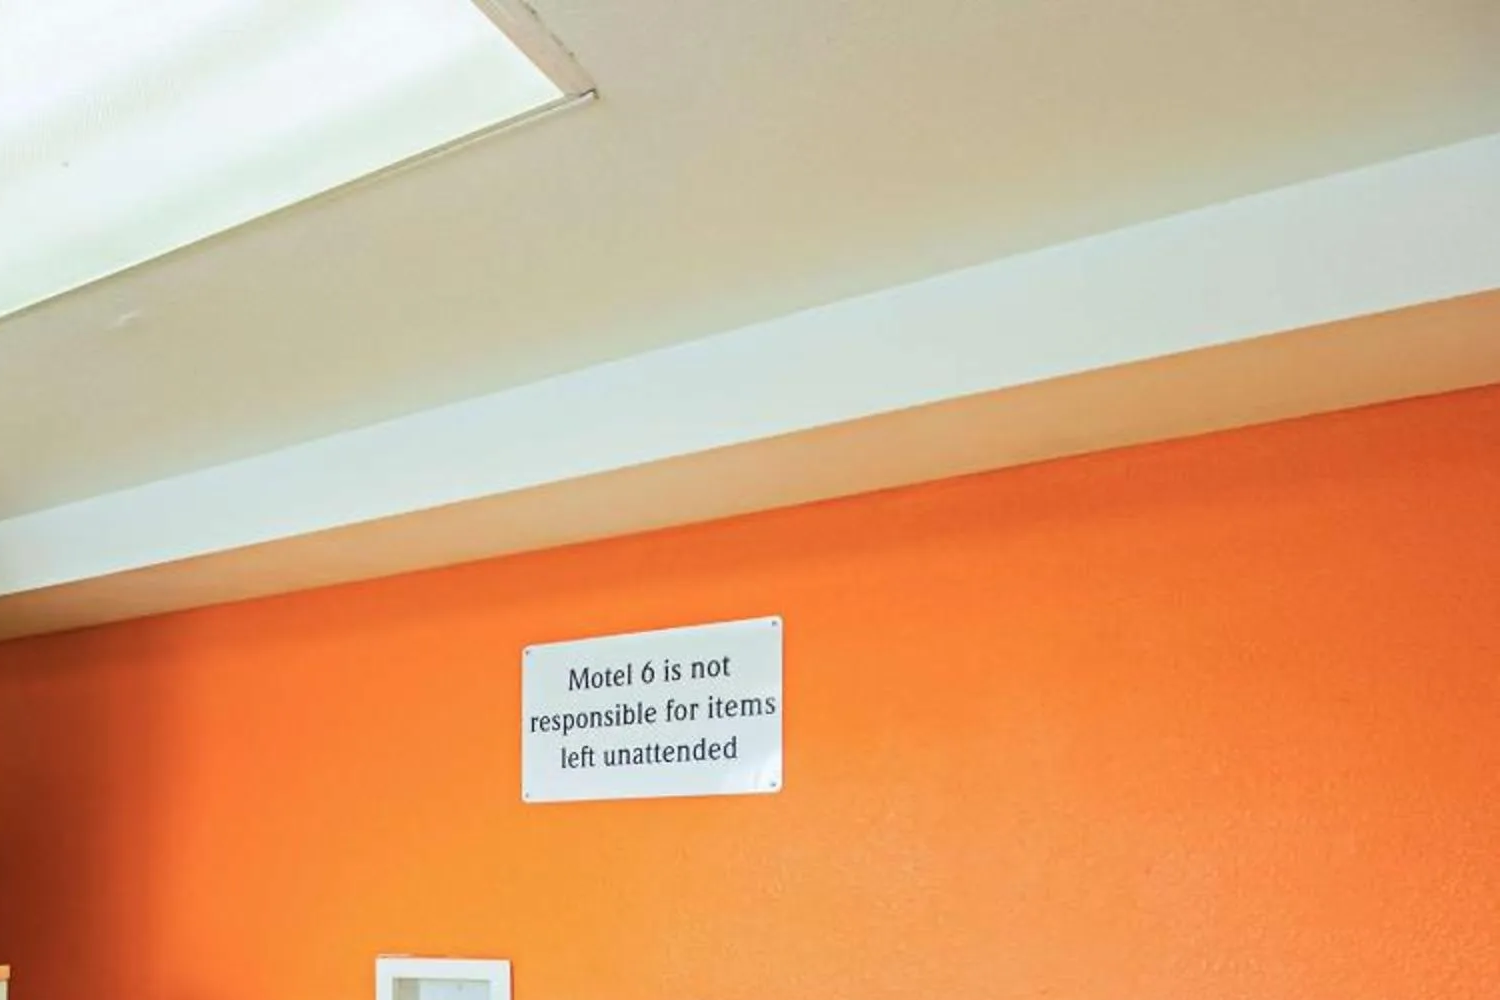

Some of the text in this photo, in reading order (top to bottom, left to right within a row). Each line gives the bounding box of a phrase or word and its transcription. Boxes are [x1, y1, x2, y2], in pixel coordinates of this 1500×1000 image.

[568, 656, 731, 691] Motel 6 is not
[531, 695, 776, 736] responsible for items
[561, 736, 738, 769] left unattended
